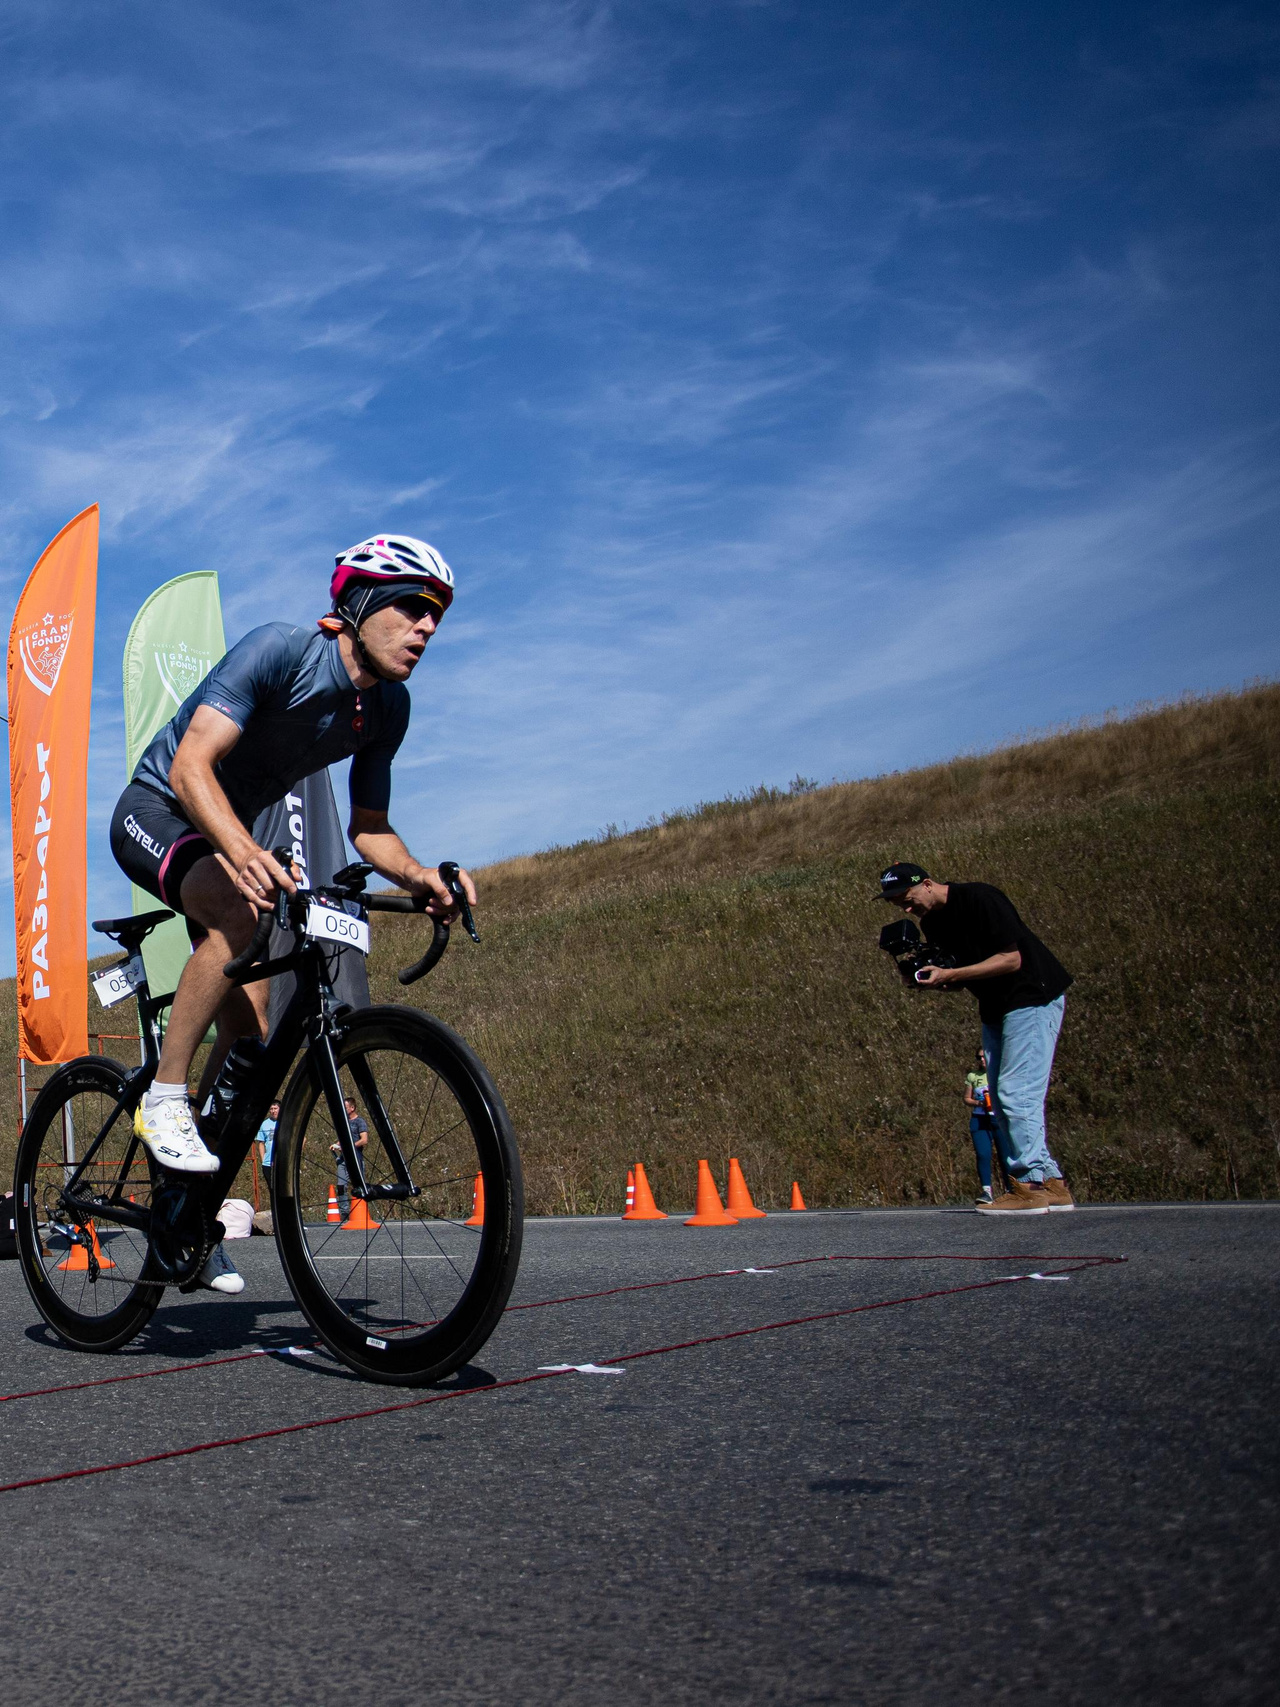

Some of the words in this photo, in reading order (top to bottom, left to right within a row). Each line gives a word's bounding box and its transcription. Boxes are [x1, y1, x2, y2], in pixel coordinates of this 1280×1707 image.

[31, 624, 68, 640] GRAN
[32, 633, 68, 649] FONDO
[169, 653, 197, 665] GRAN
[170, 660, 198, 672] FONDO
[325, 915, 359, 940] 050
[157, 1145, 183, 1159] SIDI
